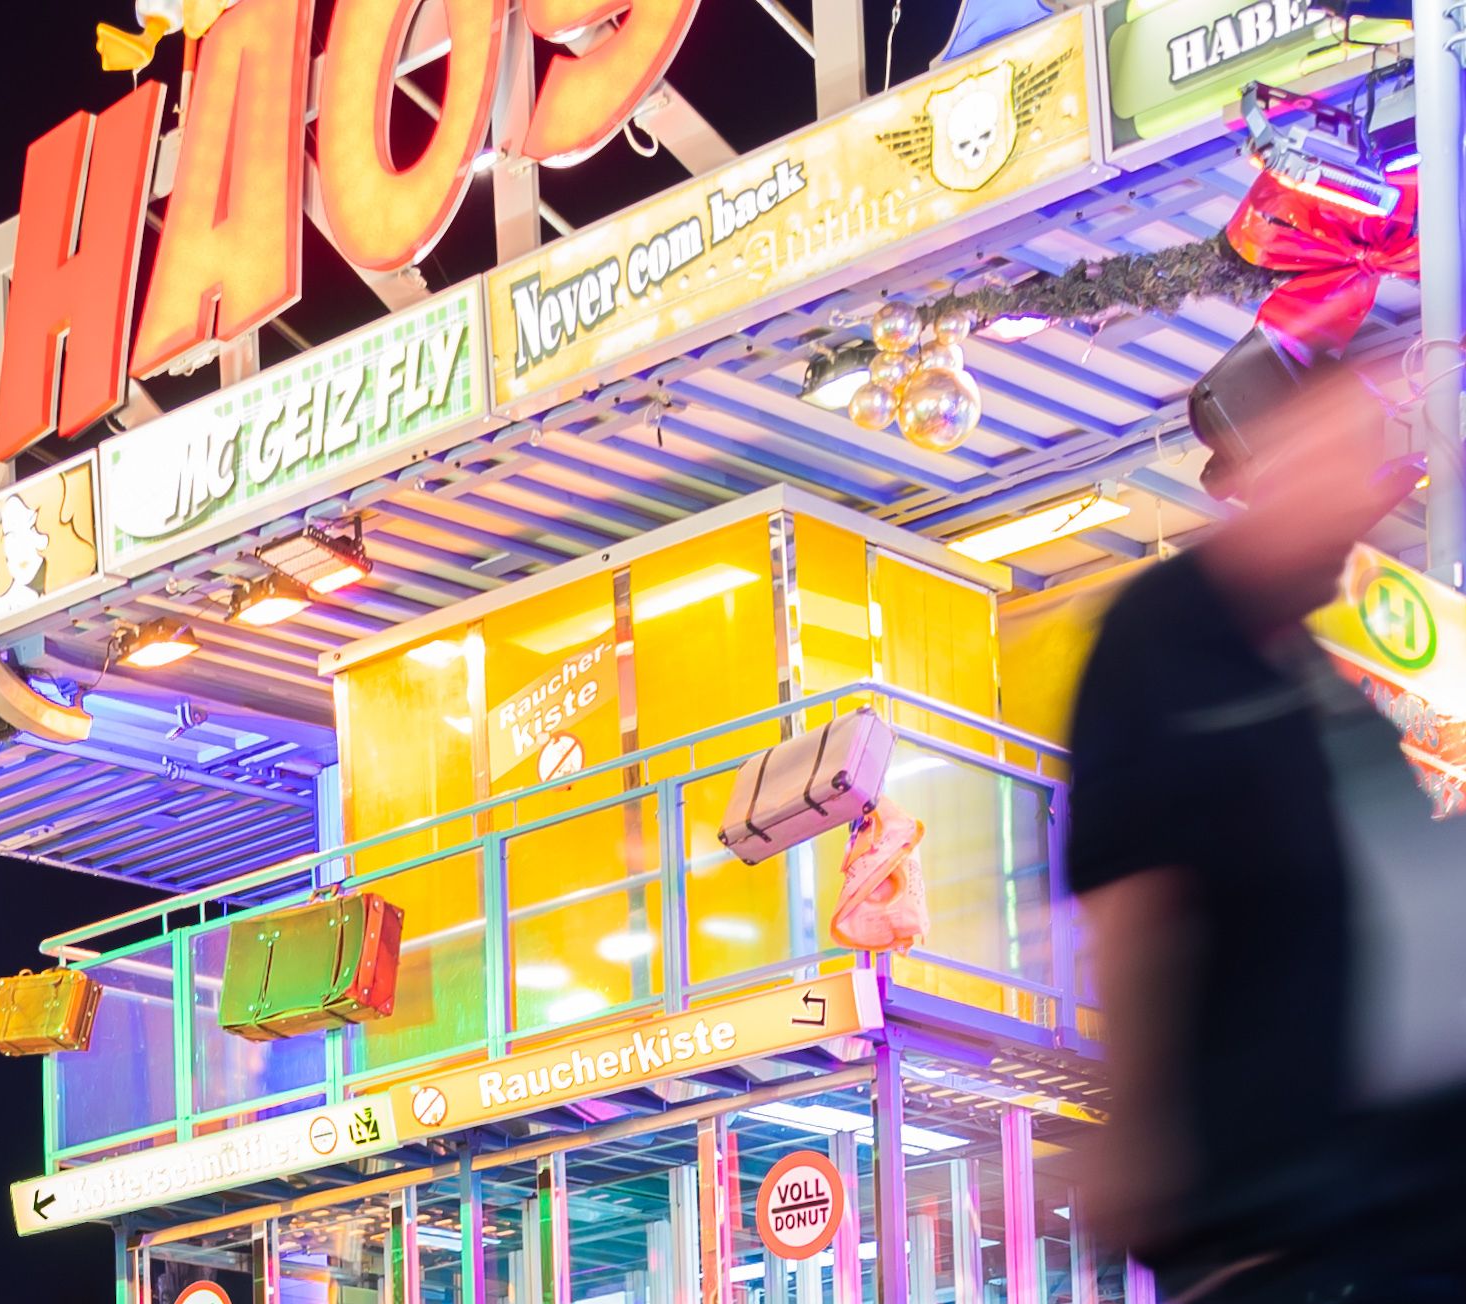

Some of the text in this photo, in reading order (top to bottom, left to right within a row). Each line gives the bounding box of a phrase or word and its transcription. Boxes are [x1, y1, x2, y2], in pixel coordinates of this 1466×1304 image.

[511, 159, 807, 376] Never com back
[167, 324, 469, 523] MC GEIZ FLY
[500, 643, 612, 730] Raucher-
[775, 1207, 828, 1231] DONUT
[778, 1179, 825, 1204] VOLL
